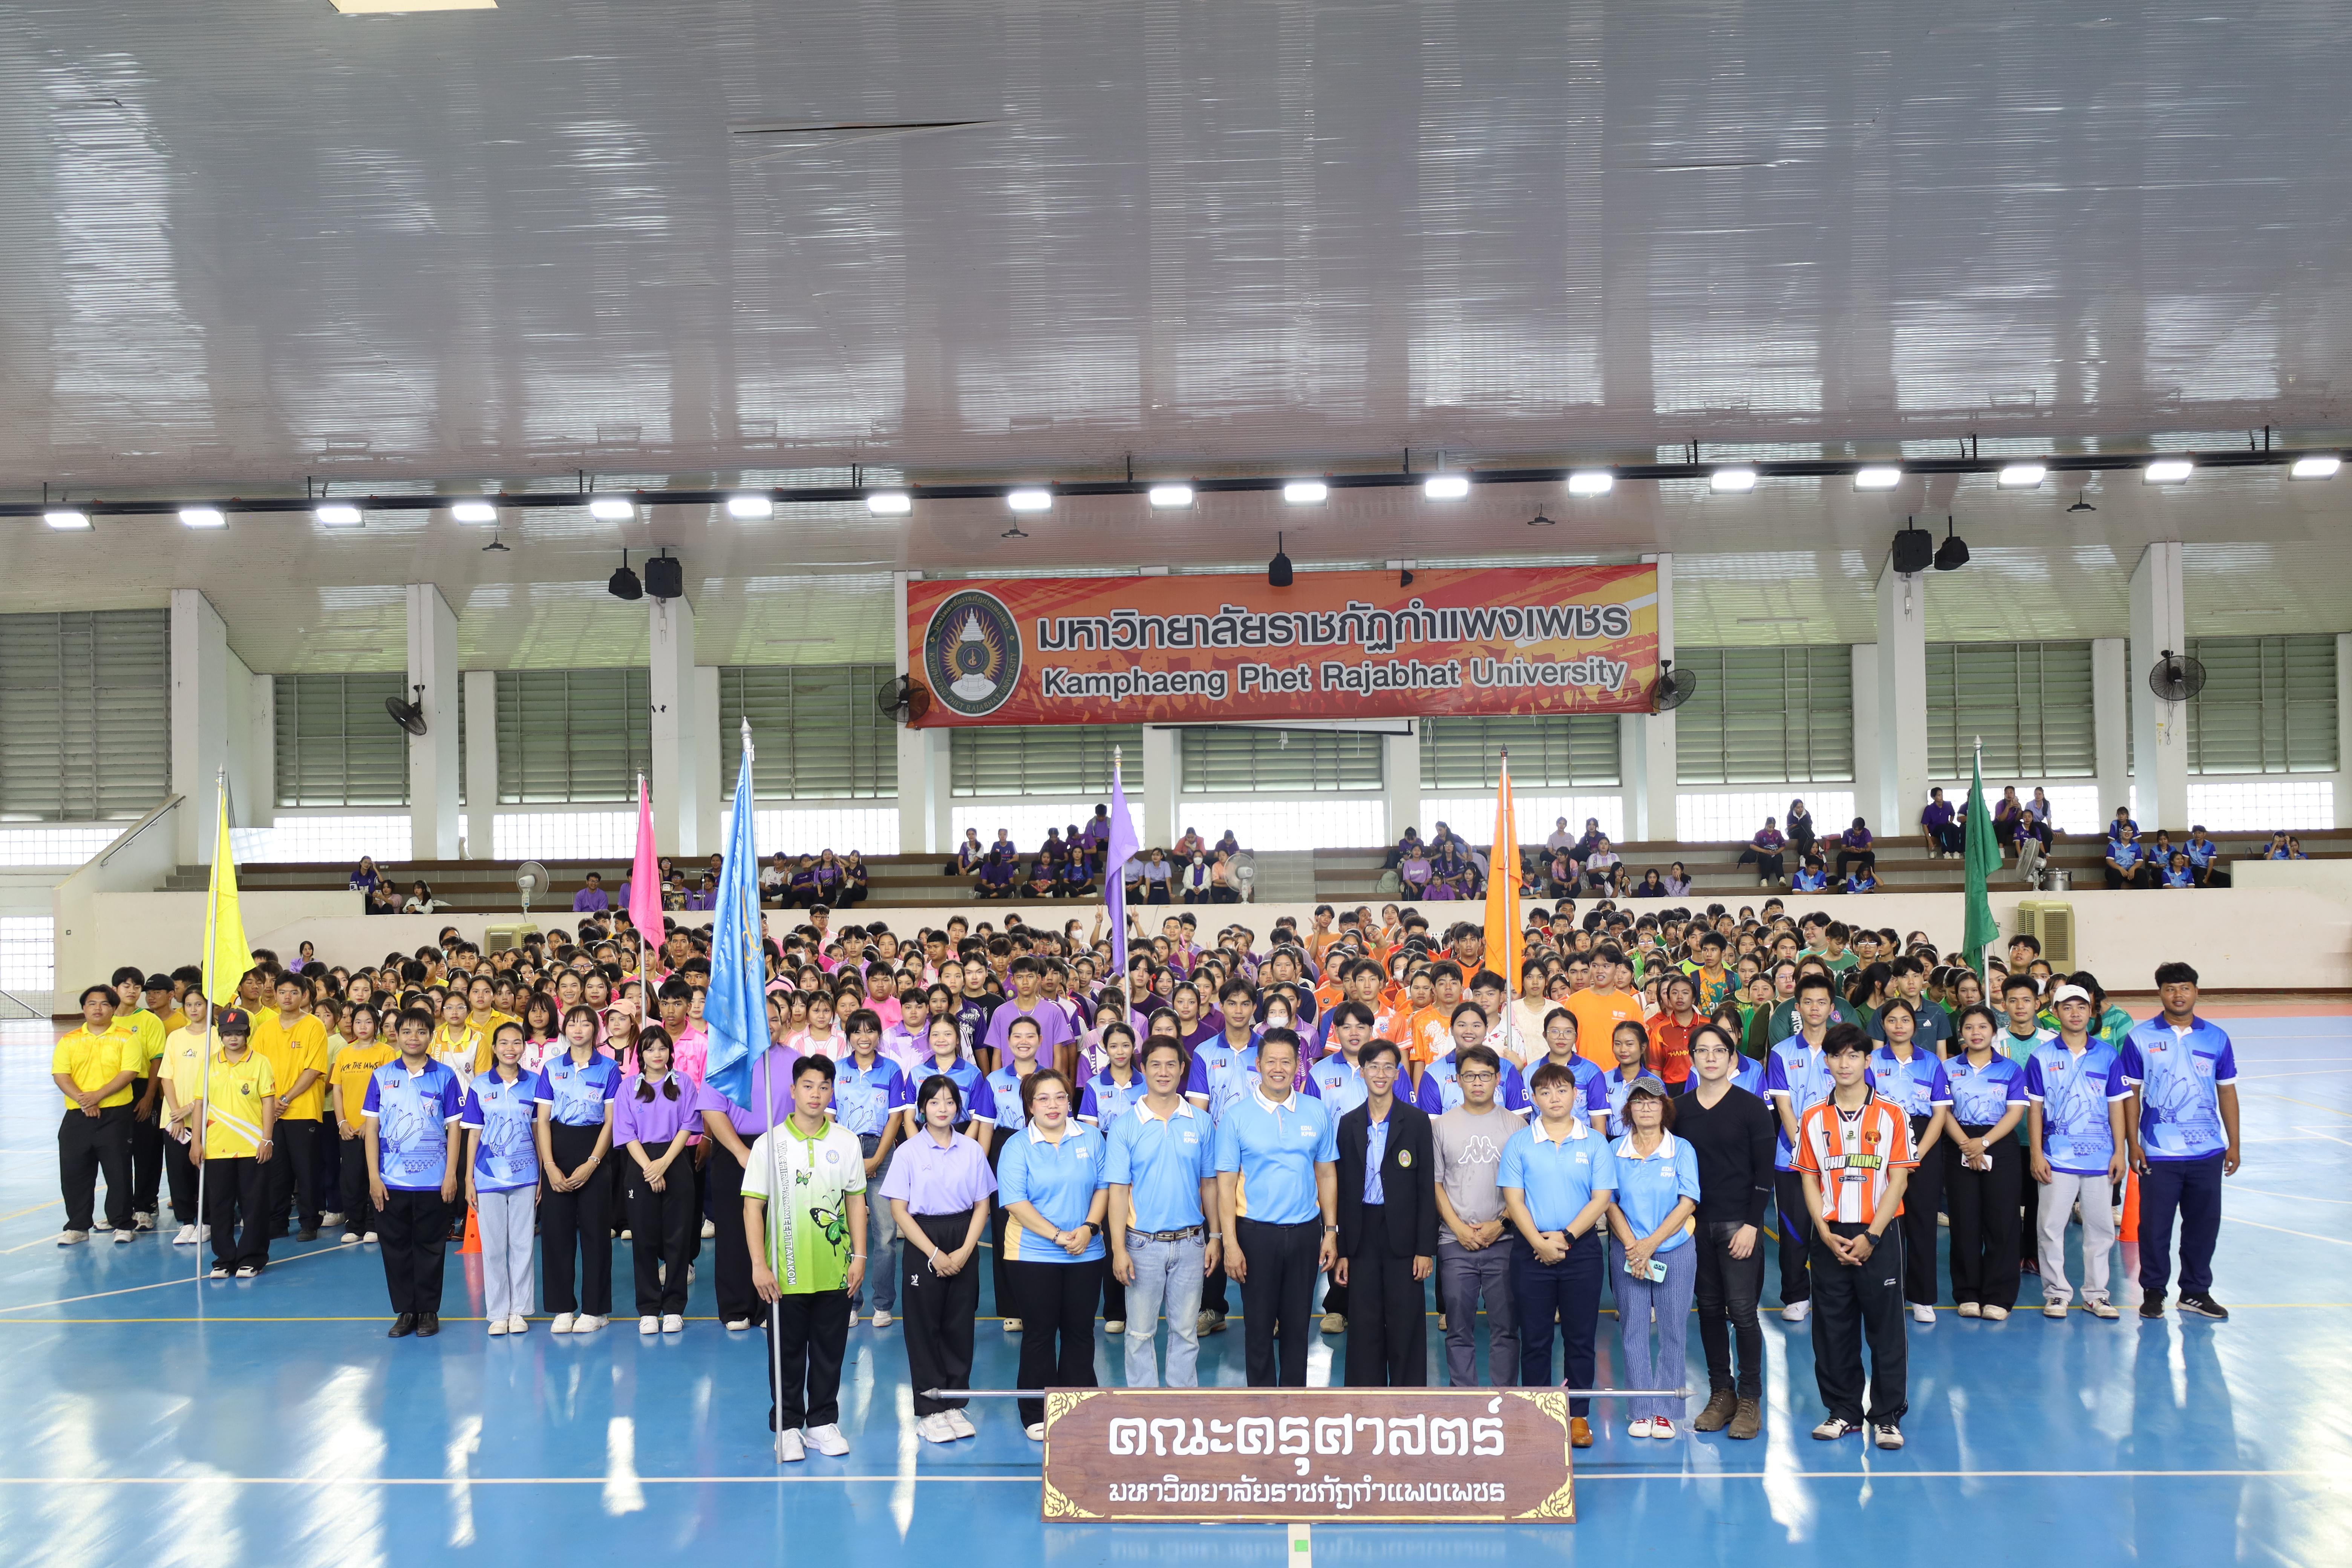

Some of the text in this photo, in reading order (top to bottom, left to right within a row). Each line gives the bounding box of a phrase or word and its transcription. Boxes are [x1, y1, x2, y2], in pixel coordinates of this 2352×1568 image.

[1039, 600, 1628, 651] มหาวิทยาลัยราชภัฏกำแพงเพชร
[929, 652, 1017, 713] KAMPHAENG PHET RAJABHAT UNIVERSITY
[1044, 658, 1625, 698] Kamphaeng Phet Rajabhat University
[227, 1012, 237, 1023] N
[352, 1062, 362, 1070] THE
[1823, 1130, 1831, 1147] 7
[1824, 1154, 1883, 1170] PHOTHONG
[777, 1141, 796, 1285] WACHIRABARAMEEPITTAYAKOM
[1109, 1396, 1505, 1476] คณะครุศาสตร์
[1109, 1474, 1505, 1509] มหาวิทยาลัยราชภัฏกำแพงเพชร
